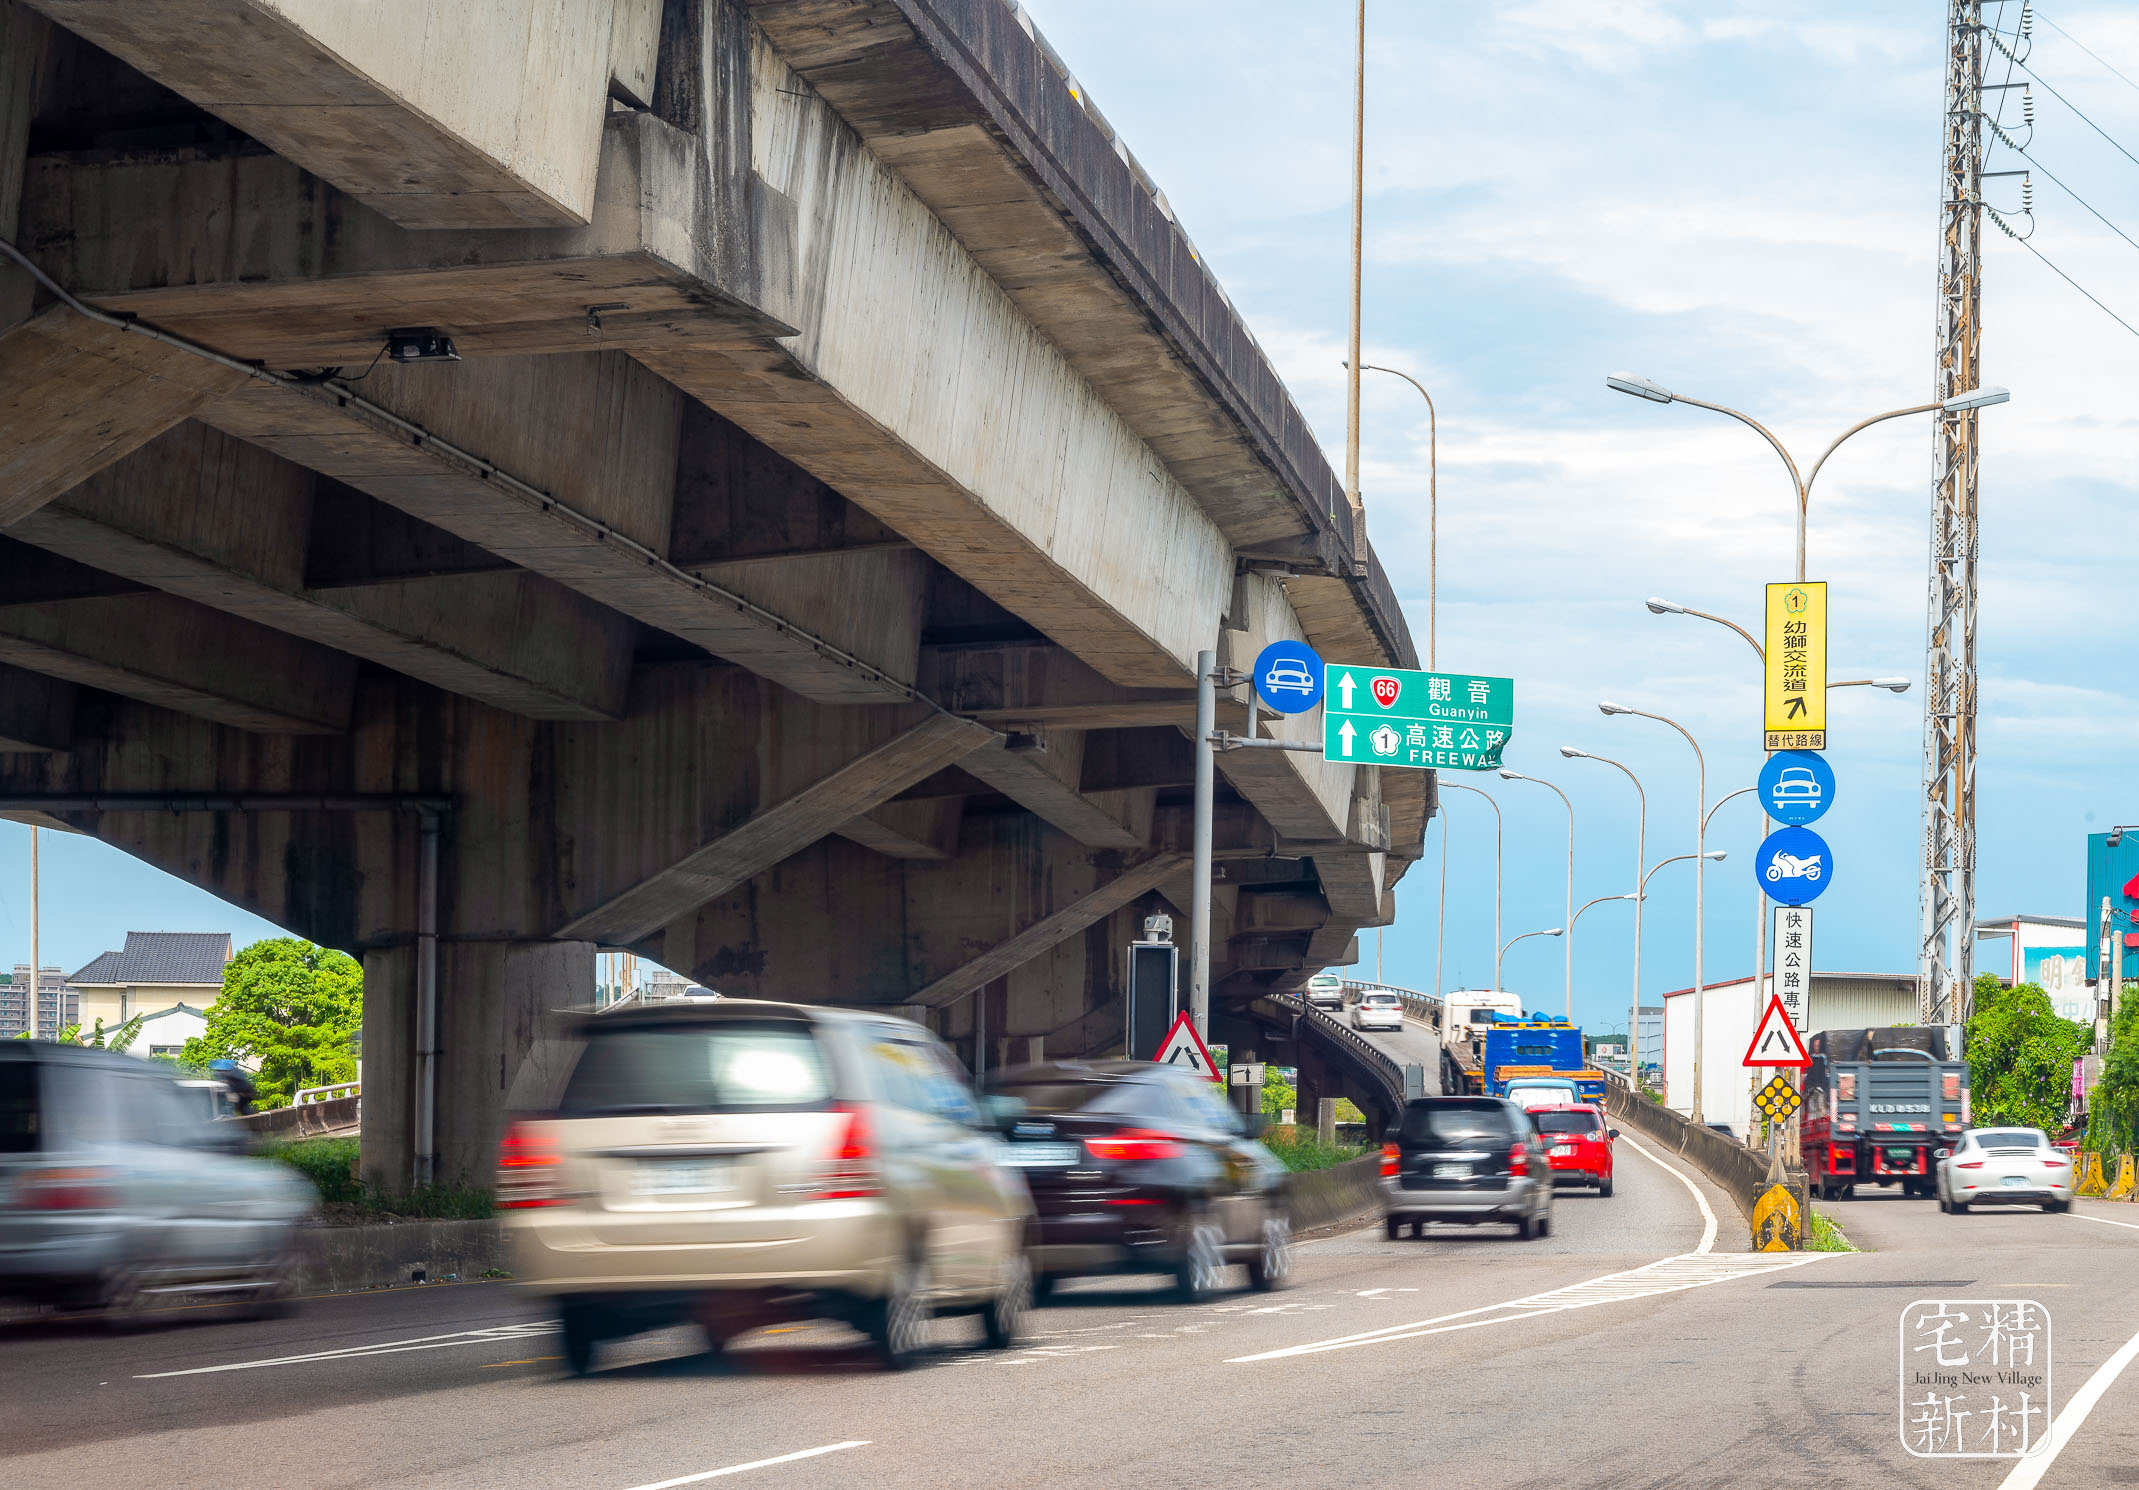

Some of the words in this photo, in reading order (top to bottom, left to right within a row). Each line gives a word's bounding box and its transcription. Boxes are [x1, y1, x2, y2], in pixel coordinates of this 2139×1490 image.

[1792, 595, 1798, 608] 1
[1783, 620, 1807, 692] 幼獅交流道
[1376, 680, 1395, 698] 66
[1428, 677, 1490, 705] 觀音
[1429, 703, 1488, 720] Guanyin
[1381, 733, 1389, 749] 1
[1406, 723, 1504, 751] 高速公路
[1767, 733, 1822, 747] 替代路線
[1783, 911, 1803, 1029] 快速公路專行
